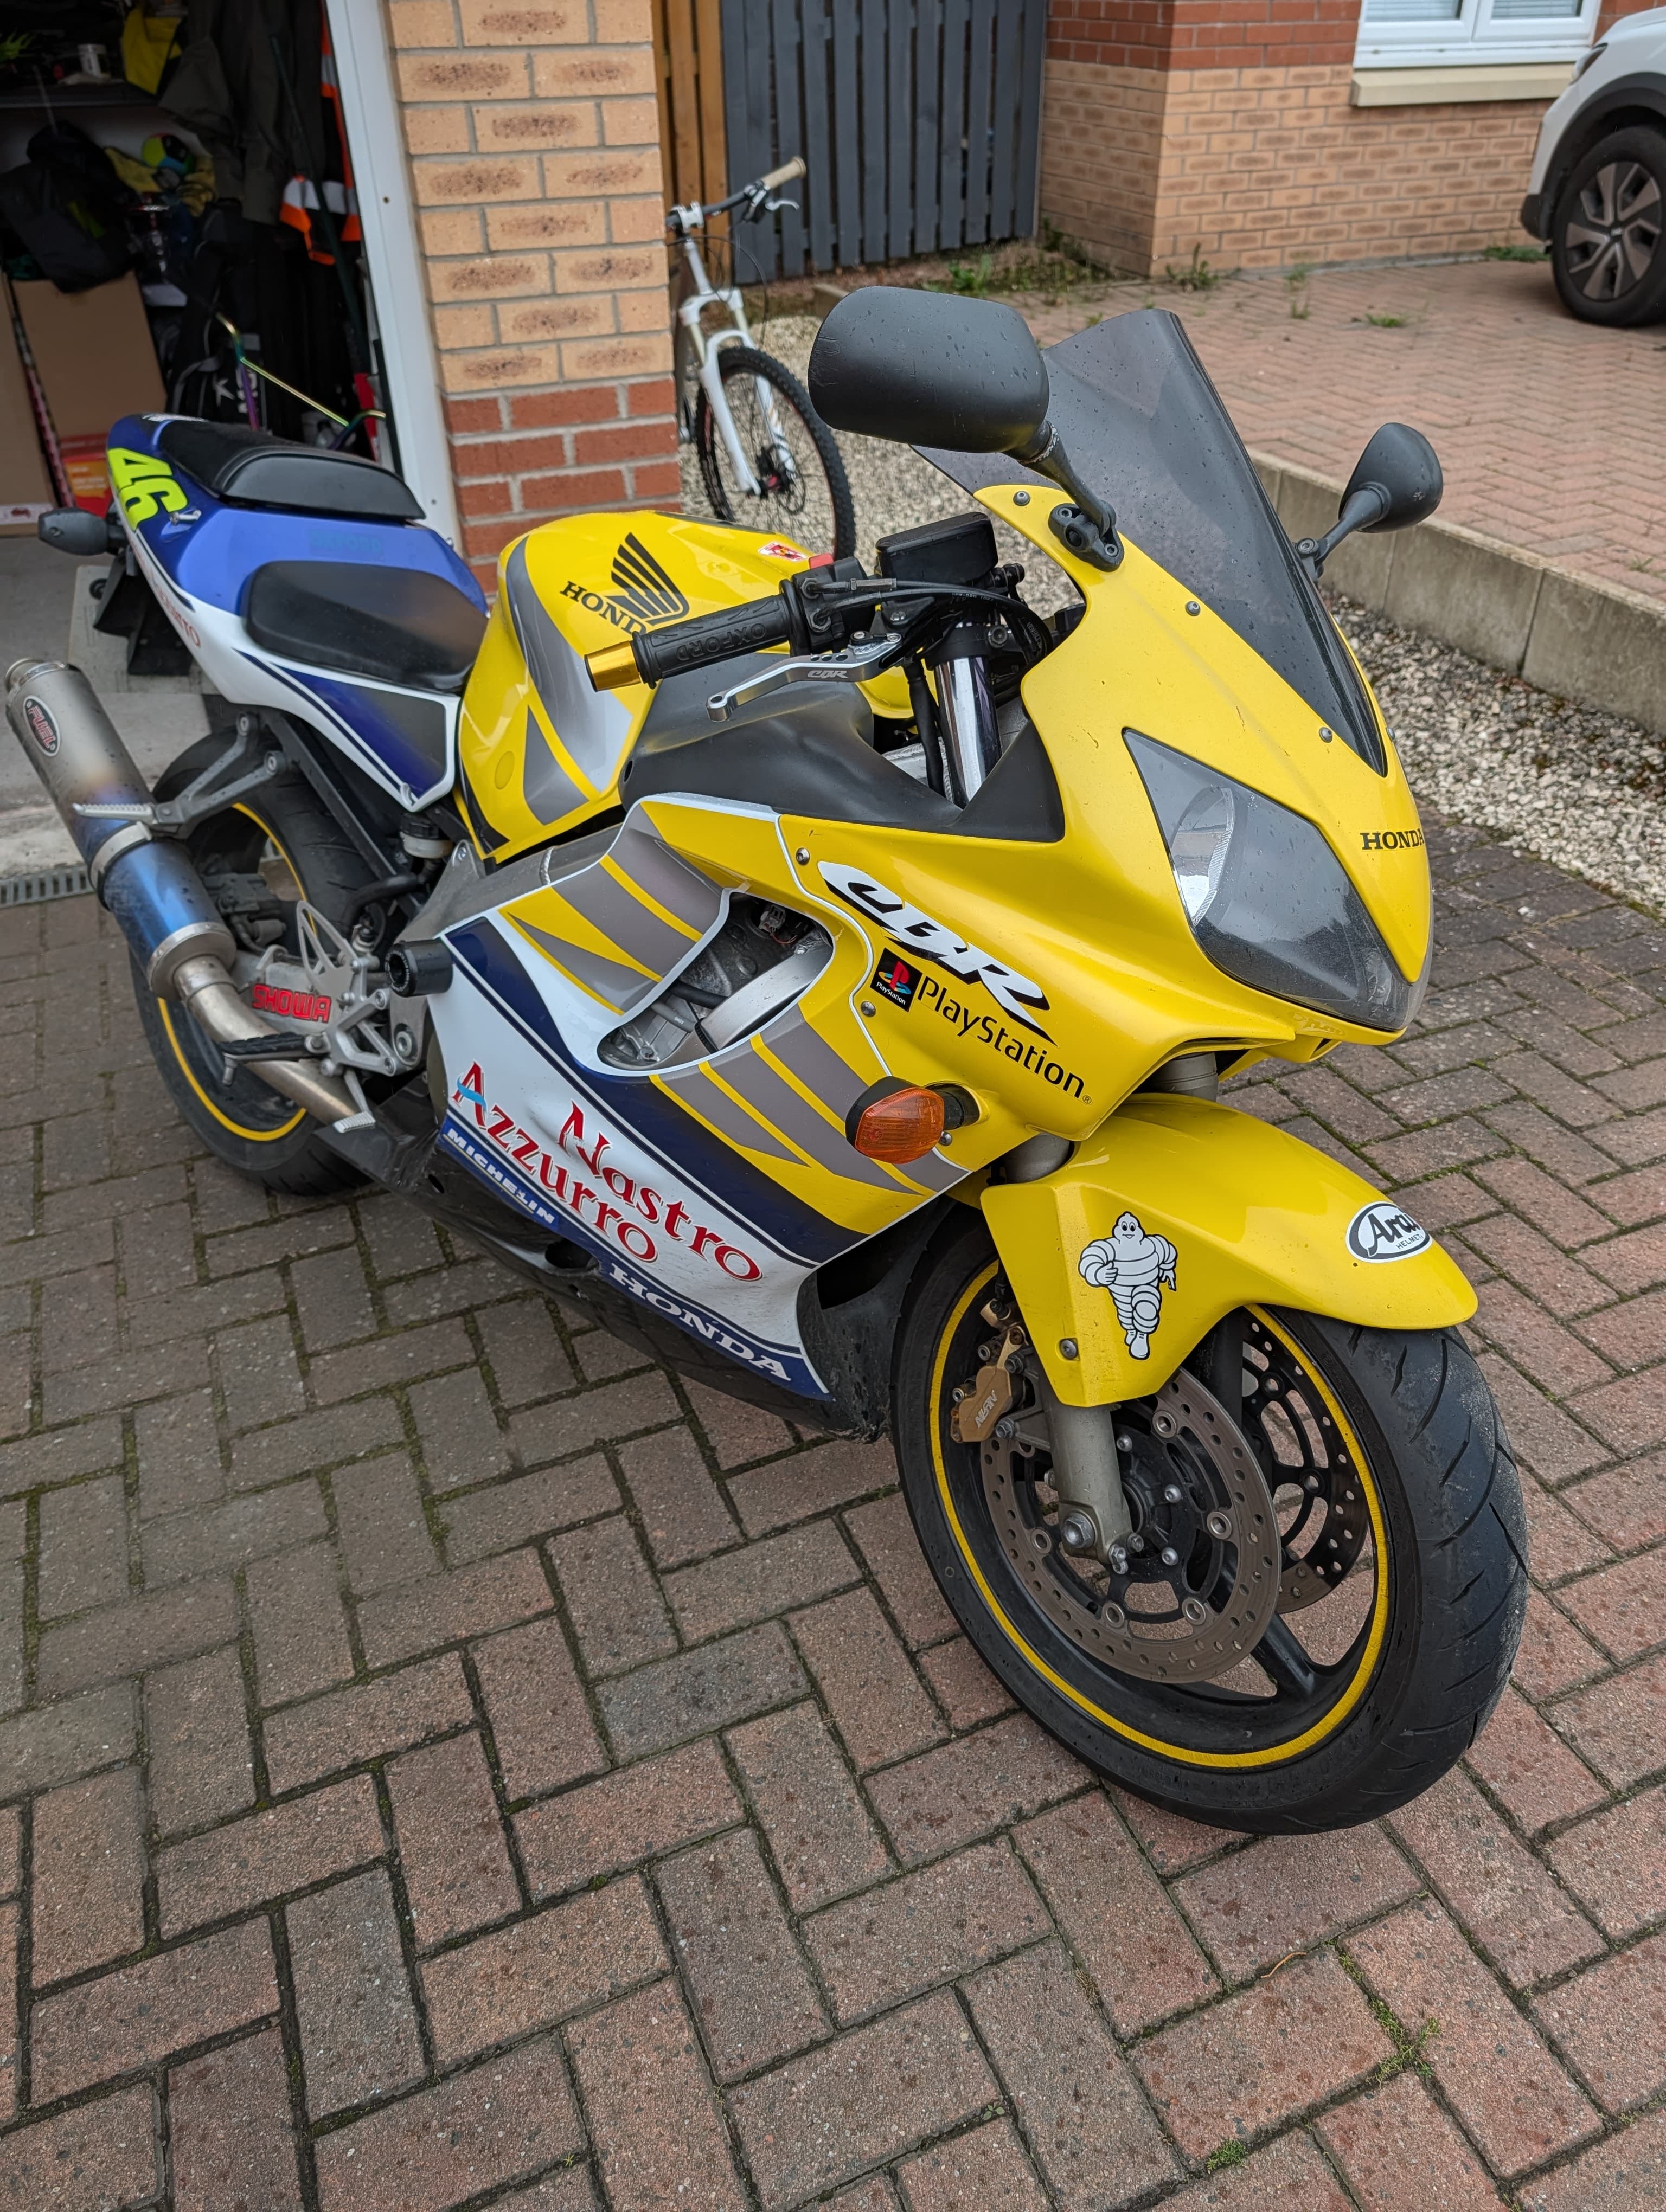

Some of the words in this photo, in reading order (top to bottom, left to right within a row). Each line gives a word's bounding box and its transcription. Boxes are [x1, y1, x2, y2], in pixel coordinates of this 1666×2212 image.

[107, 447, 188, 531] 46
[560, 581, 647, 636] HOND
[676, 623, 766, 661] OXFORD
[807, 670, 849, 679] CBR
[27, 705, 56, 749] FUEL
[1360, 828, 1425, 850] HONDA
[817, 860, 1058, 1047] CBR
[252, 983, 332, 1024] SHOWA
[876, 981, 906, 1005] PlayStation
[917, 976, 1085, 1099] PlayStation
[447, 1128, 555, 1224] MICHELIN
[451, 1061, 658, 1263] Azzurro
[557, 1099, 763, 1282] Nastro
[609, 1263, 792, 1381] HONDA
